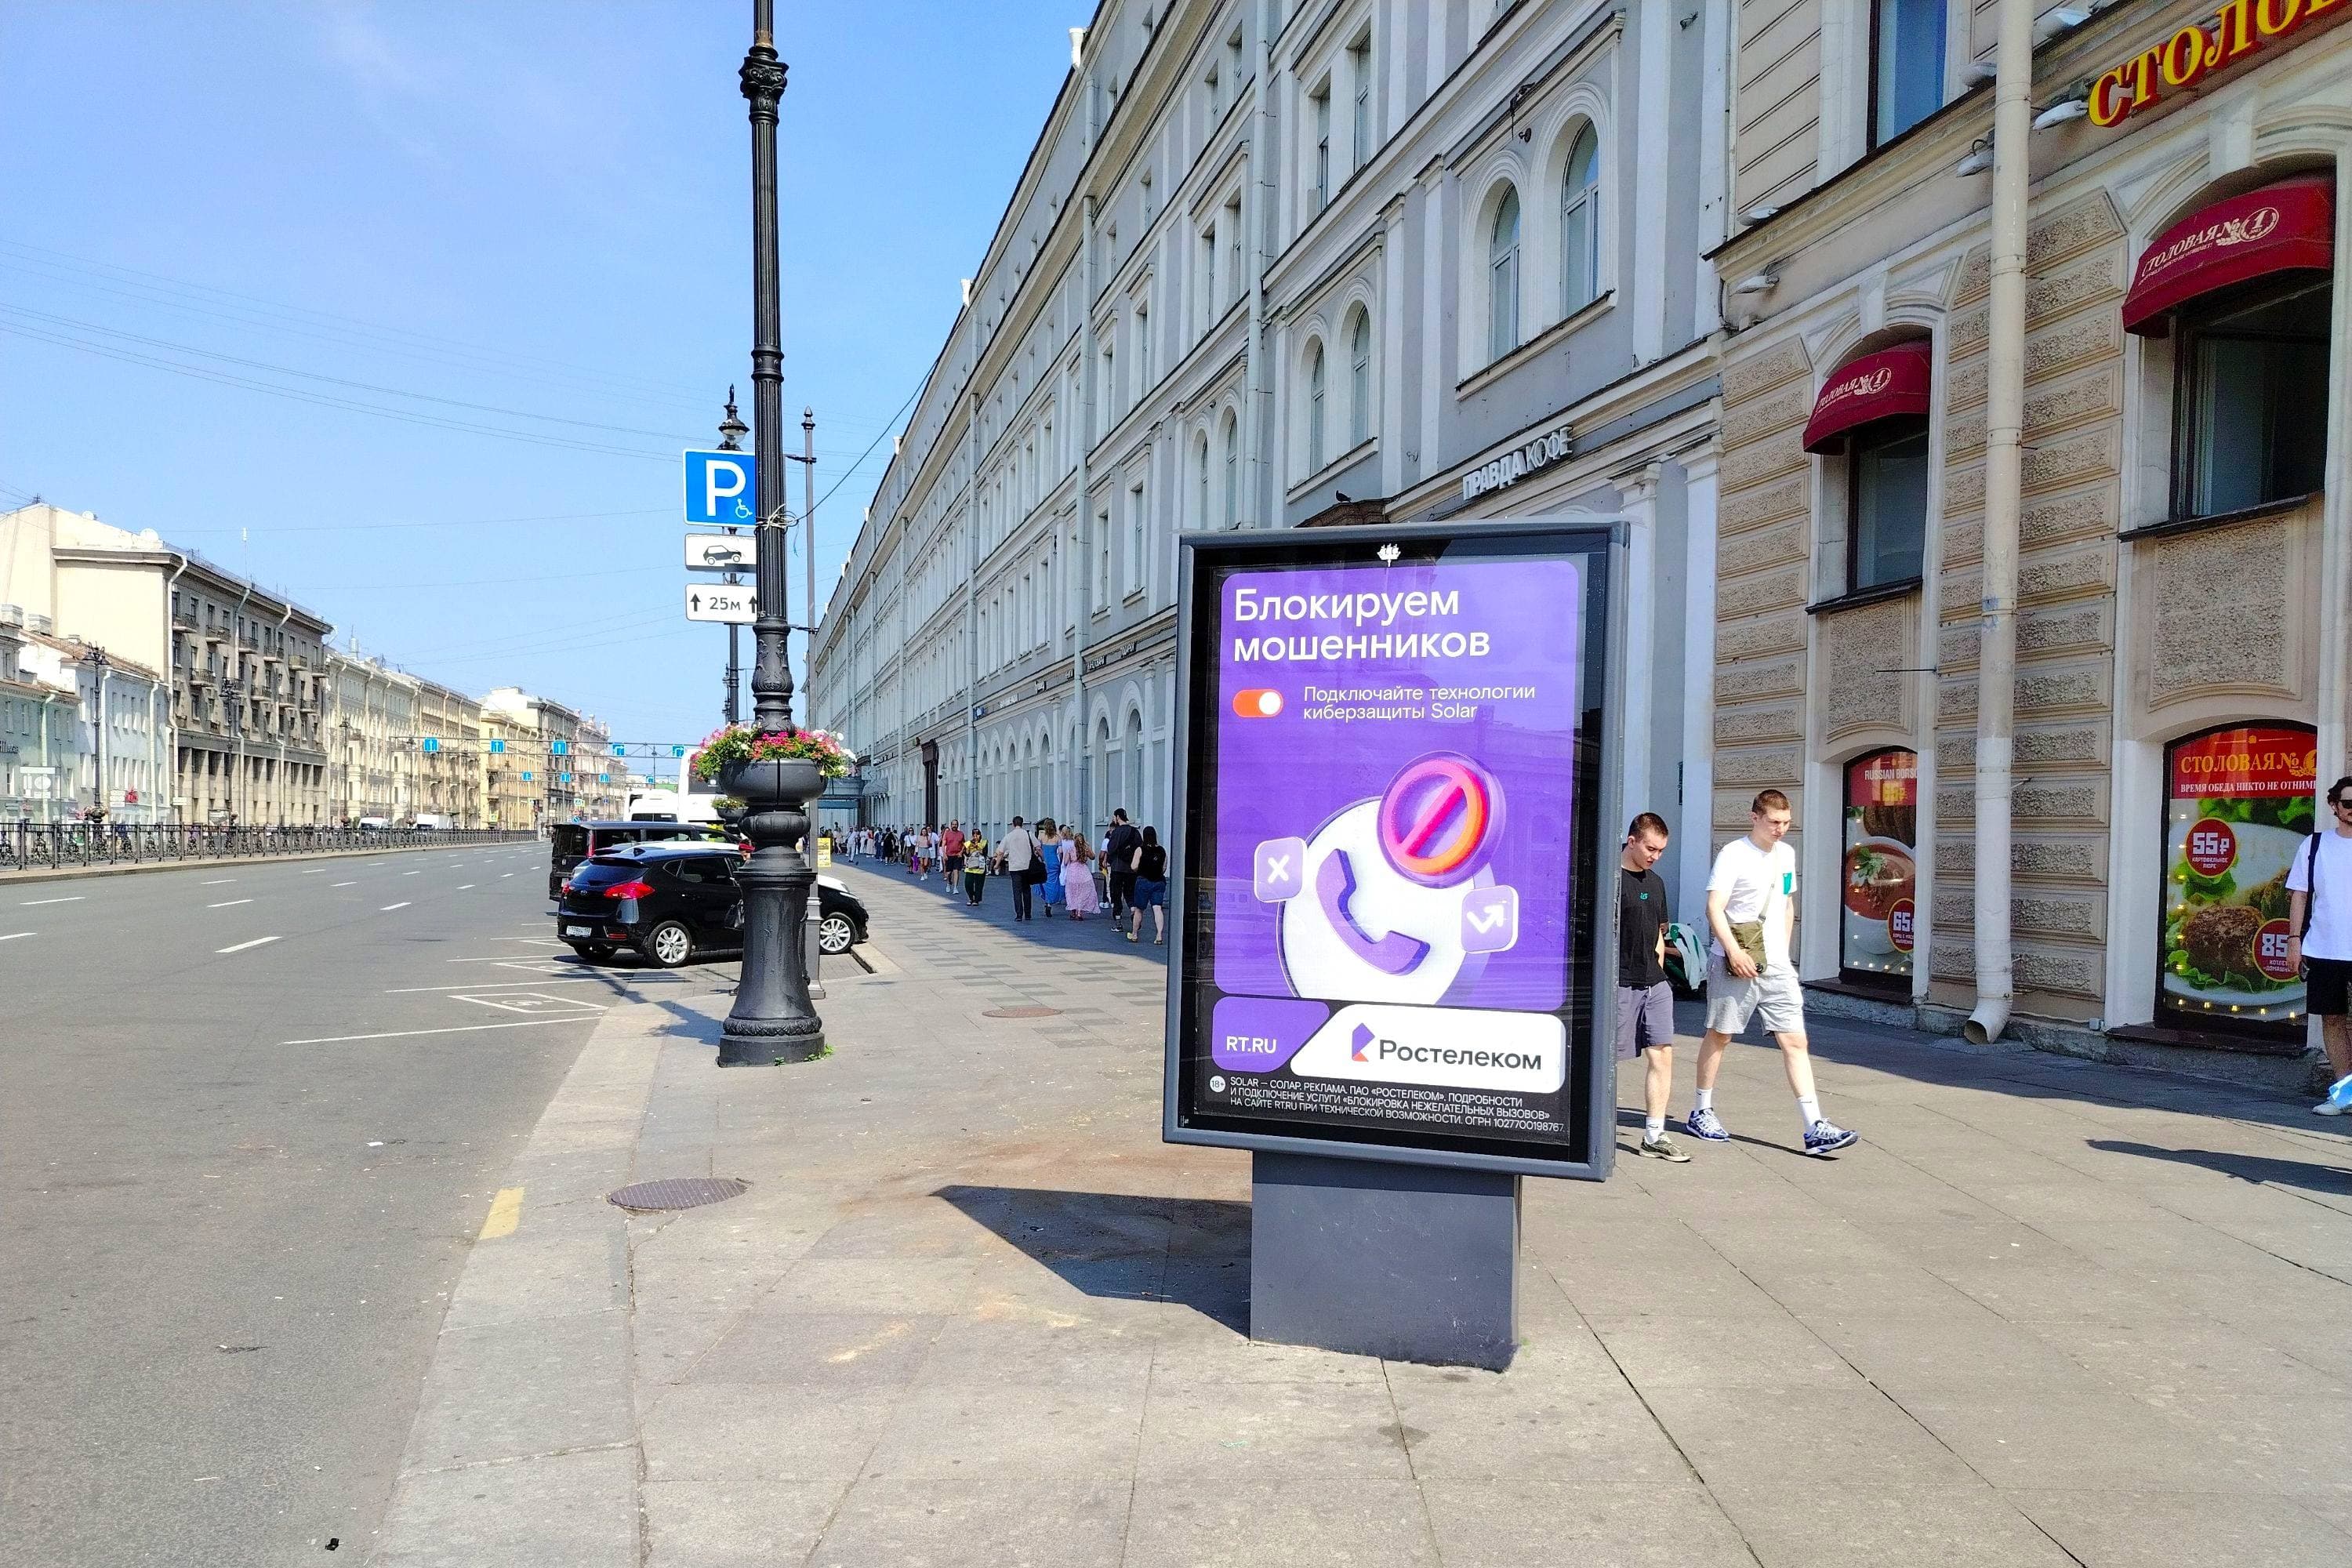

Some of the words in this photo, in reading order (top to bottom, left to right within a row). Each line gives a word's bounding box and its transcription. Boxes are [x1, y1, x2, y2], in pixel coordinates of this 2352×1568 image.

[2089, 0, 2336, 126] СТОЛО
[1462, 450, 1528, 501] ПРАВДА
[1525, 426, 1573, 471] КОФЕ
[1235, 588, 1459, 627] Блокируем
[1234, 631, 1490, 662] мошенников
[1303, 685, 1424, 703] Подключайте
[1428, 684, 1536, 700] технологии
[1303, 704, 1425, 723] киберзащиты
[1430, 702, 1478, 719] Solar
[1864, 768, 1895, 781] RUSSIAN
[2180, 752, 2276, 774] СТОЛОВАЯ
[2276, 752, 2300, 770] №
[2180, 783, 2207, 793] ВРЕМЯ
[2208, 782, 2235, 793] ОБЕДА
[2236, 782, 2265, 791] НИКТО
[2267, 781, 2279, 790] НЕ
[2193, 832, 2230, 855] 55₽
[1226, 1035, 1277, 1054] RT.RU
[1379, 1039, 1542, 1070] Ростелеком
[1210, 1080, 1225, 1088] 18+
[1230, 1076, 1259, 1087] SOLAR
[1269, 1080, 1302, 1091] СОЛАР.
[1304, 1082, 1348, 1094] РЕКЛАМА.
[1349, 1085, 1369, 1095] ПАО
[1371, 1087, 1446, 1102] «РОСТЕЛЕКОМ».
[1448, 1092, 1523, 1107] ПОДРОБНОСТИ
[1230, 1087, 1237, 1096] И
[1239, 1087, 1305, 1102] ПОДКЛЮЧЕНИЕ
[1306, 1092, 1341, 1104] УСЛУГИ
[1342, 1095, 1410, 1109] «БЛОКИРОВКА
[1411, 1102, 1494, 1116] НЕЖЕЛАТЕЛЬНЫХ
[1496, 1107, 1550, 1120] ВЫЗОВОВ»
[1230, 1098, 1242, 1106] НА
[1244, 1098, 1272, 1109] САЙТЕ
[1274, 1101, 1298, 1111] RT.RU
[1298, 1103, 1318, 1112] ПРИ
[1319, 1104, 1384, 1118] ТЕХНИЧЕСКОЙ
[1385, 1109, 1464, 1124] ВОЗМОЖНОСТИ.
[1465, 1116, 1491, 1127] ОГРН
